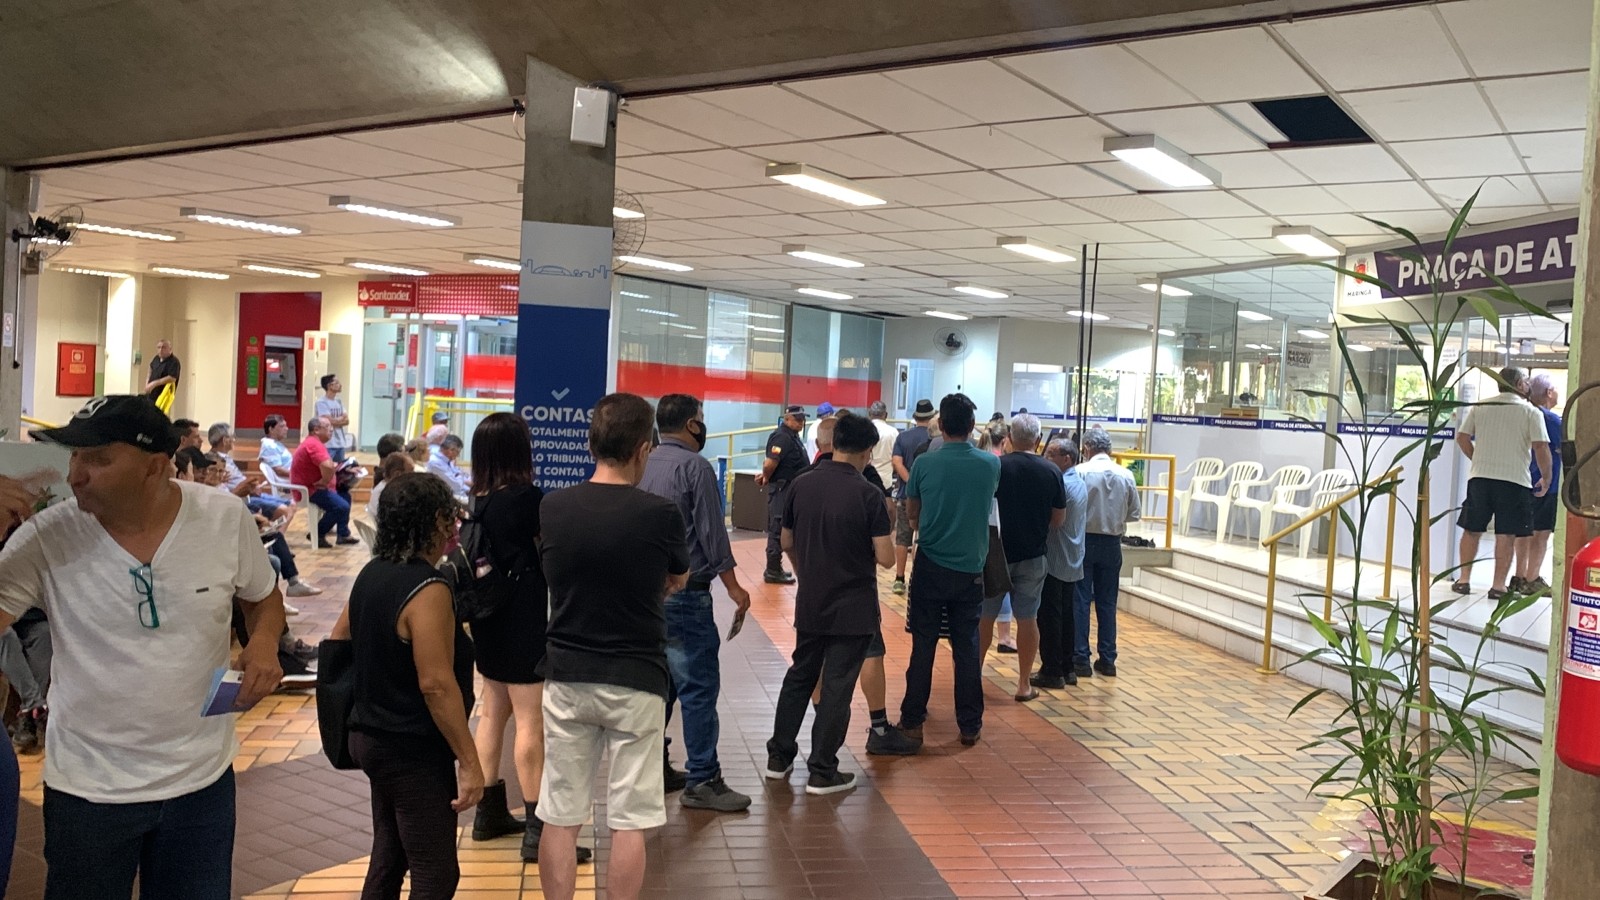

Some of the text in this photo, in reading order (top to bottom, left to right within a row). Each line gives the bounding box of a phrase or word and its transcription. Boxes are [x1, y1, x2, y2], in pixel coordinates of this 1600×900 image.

[1398, 249, 1486, 289] PRAÇA
[1494, 241, 1534, 276] DE
[369, 289, 410, 301] Santander
[521, 405, 595, 423] CONTAS
[529, 427, 589, 438] OTALMENTE
[546, 454, 595, 464] TRIBUNAL
[543, 467, 585, 477] CONTAS
